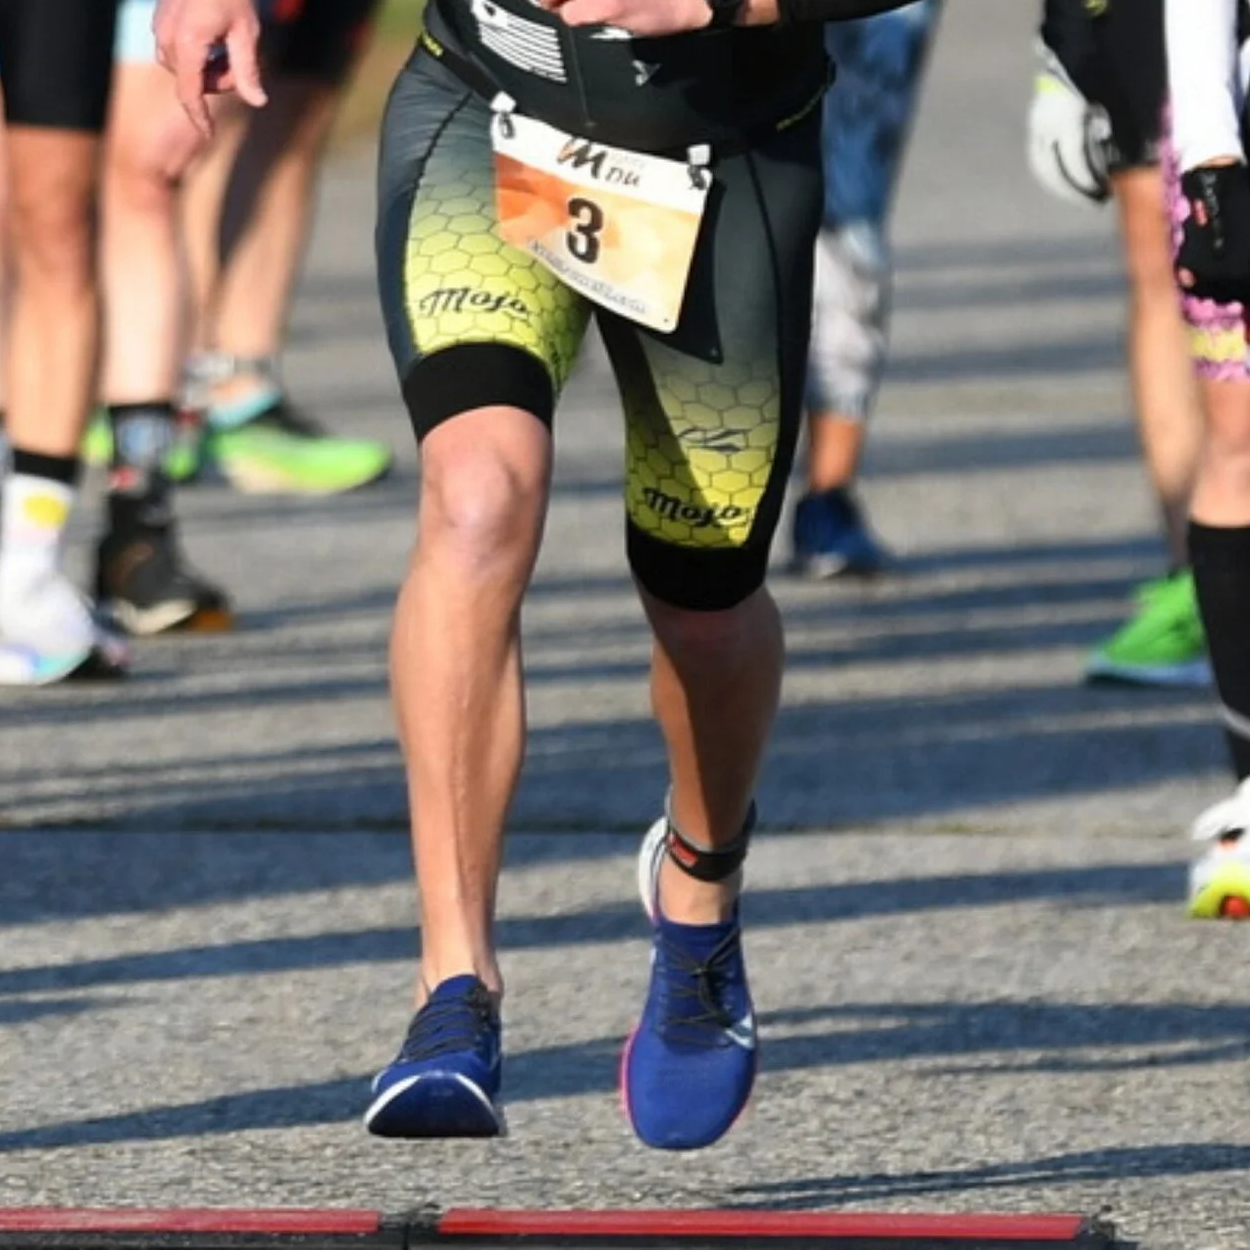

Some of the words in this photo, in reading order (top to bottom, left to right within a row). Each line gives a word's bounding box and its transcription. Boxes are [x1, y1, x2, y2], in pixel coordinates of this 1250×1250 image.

[565, 197, 604, 265] 3
[419, 286, 529, 318] Mojo
[641, 486, 744, 529] Mojo
